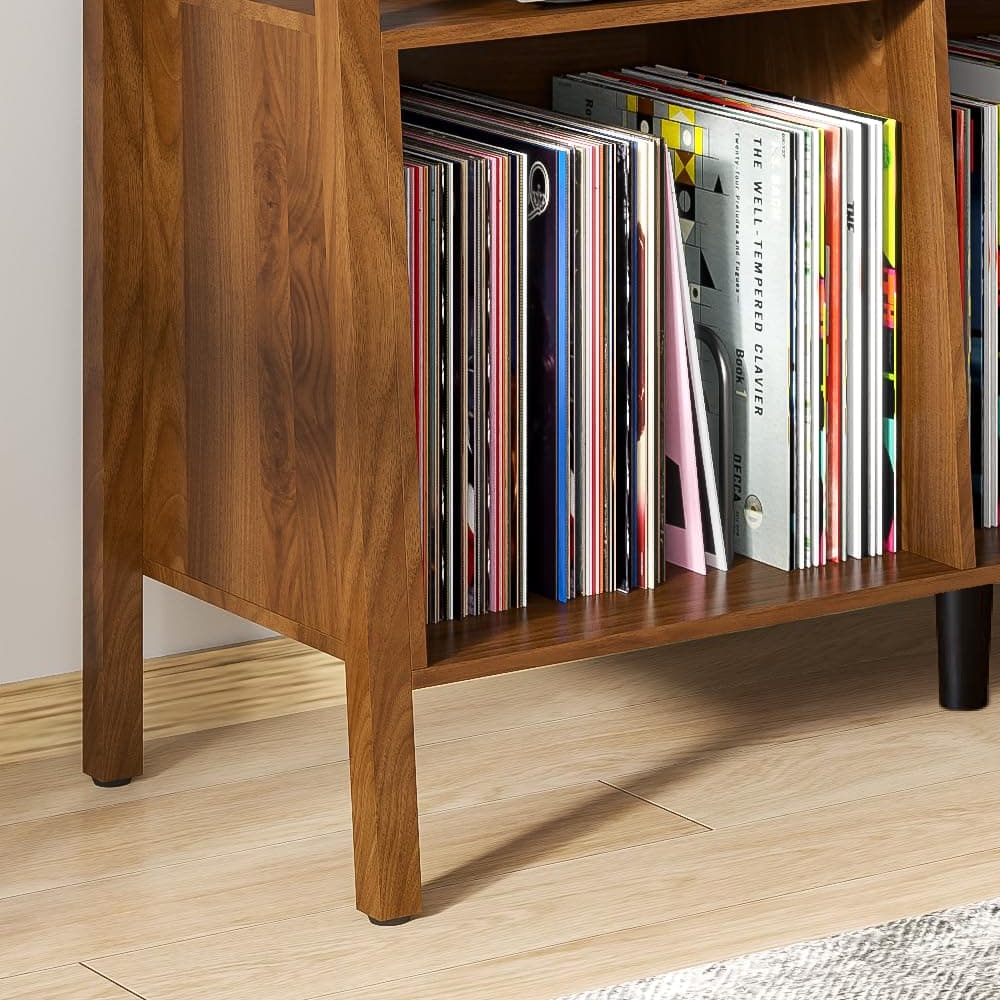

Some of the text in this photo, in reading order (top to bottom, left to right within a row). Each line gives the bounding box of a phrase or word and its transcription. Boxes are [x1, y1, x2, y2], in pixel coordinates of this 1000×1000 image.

[753, 137, 763, 169] THE
[735, 349, 747, 399] Book 1
[754, 344, 764, 416] CLAVIER
[732, 454, 742, 501] DECCA
